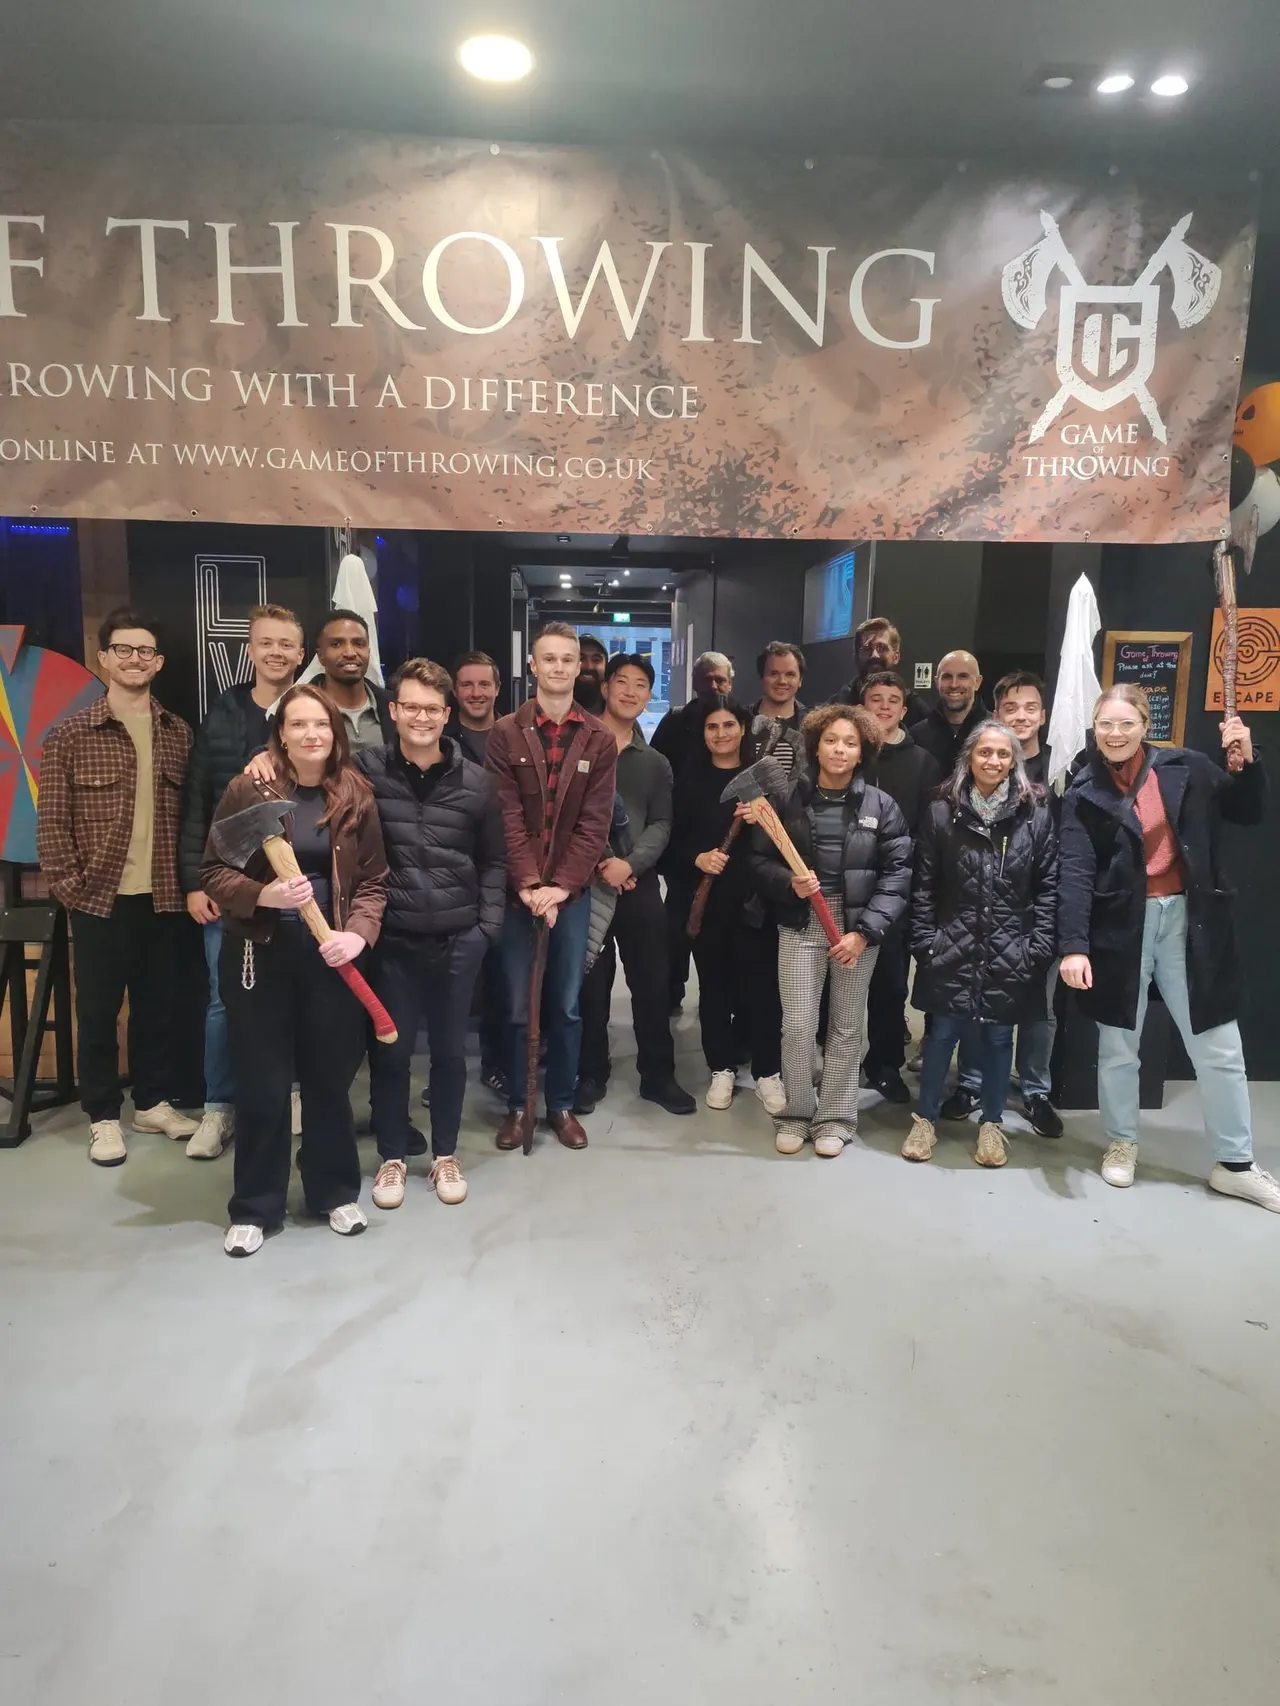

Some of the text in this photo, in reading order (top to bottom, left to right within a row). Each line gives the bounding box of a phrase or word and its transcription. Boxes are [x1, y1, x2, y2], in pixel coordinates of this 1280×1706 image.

[105, 216, 942, 349] THROWING
[0, 361, 699, 419] ROWING WITH A DIFFERENCE
[1060, 423, 1139, 445] GAME
[0, 438, 656, 481] ONLINE AT WWW.GAMEOFTHROWING.CO.UK
[1092, 445, 1105, 454] OF
[1022, 455, 1170, 481] THROWING
[1213, 691, 1273, 703] ECAPE
